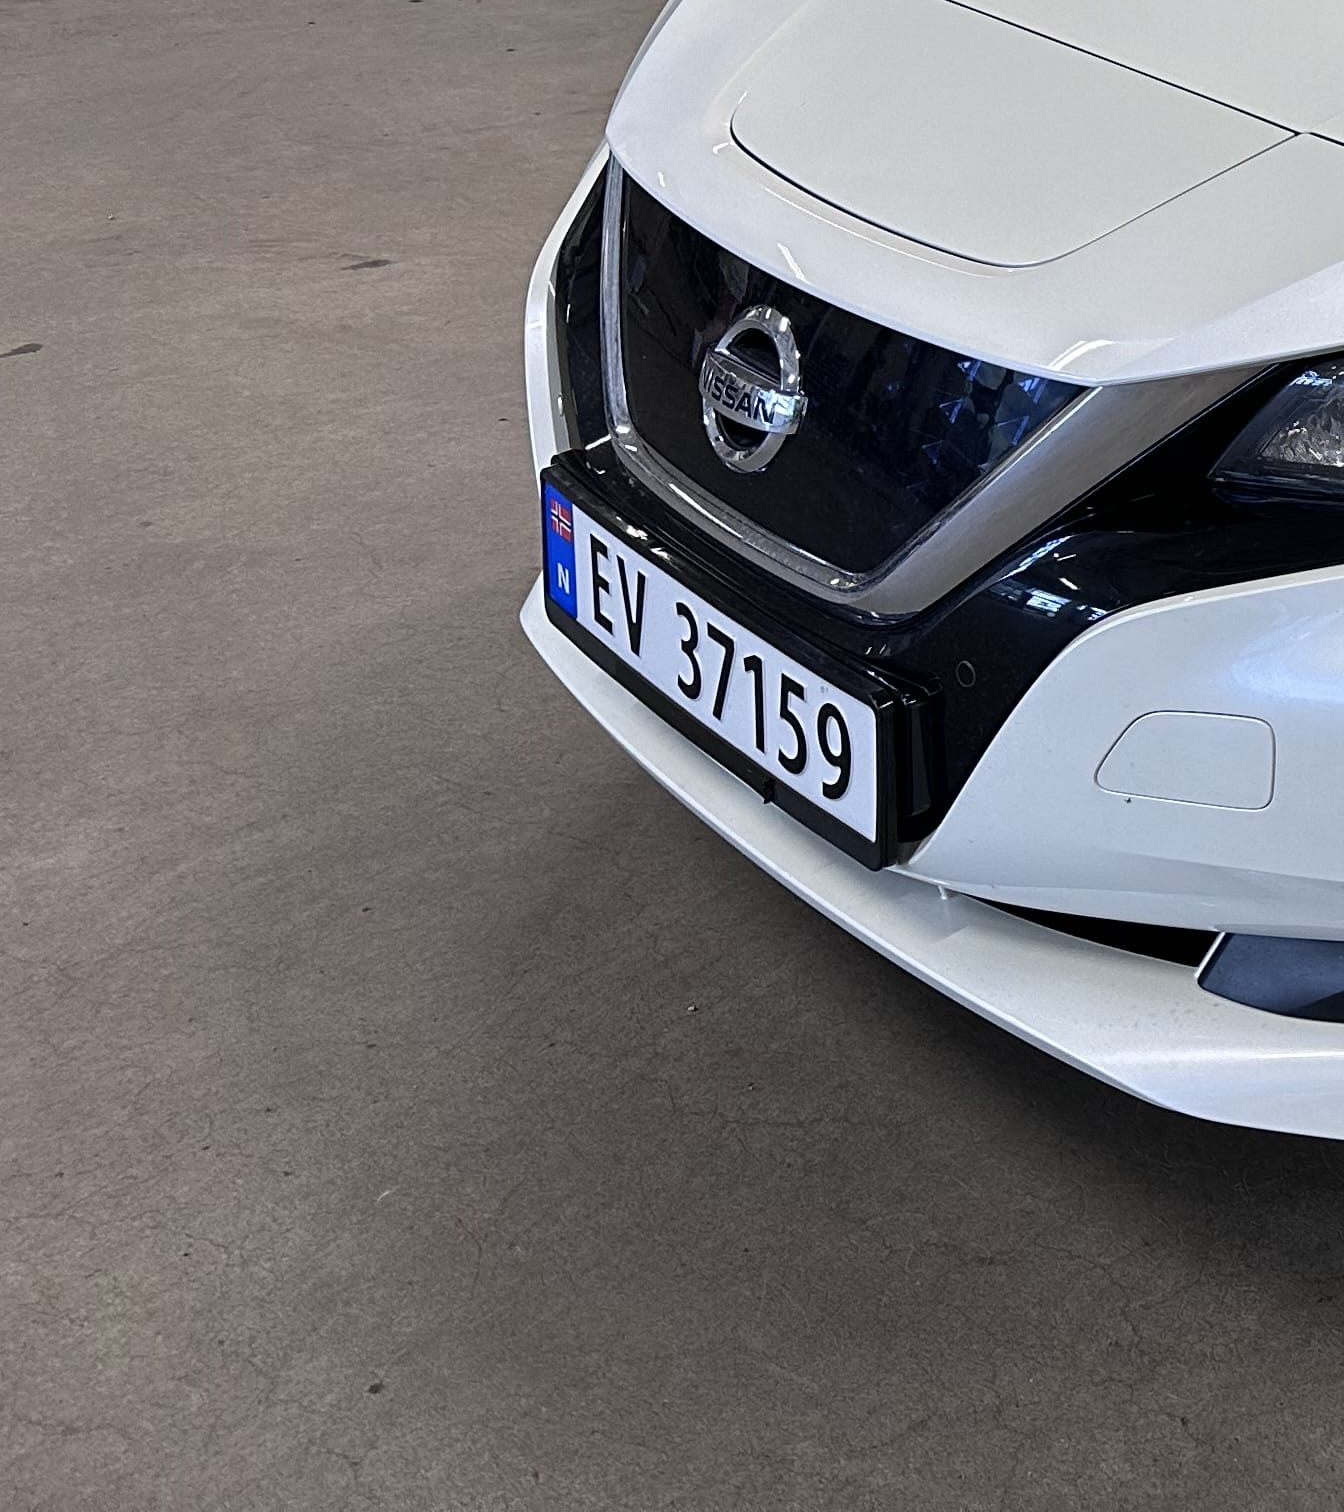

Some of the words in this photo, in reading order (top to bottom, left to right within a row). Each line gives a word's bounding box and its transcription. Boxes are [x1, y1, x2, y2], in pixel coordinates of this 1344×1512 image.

[701, 364, 775, 425] NISSAN
[557, 562, 570, 595] N
[590, 533, 647, 658] EV
[675, 601, 852, 800] 37159
